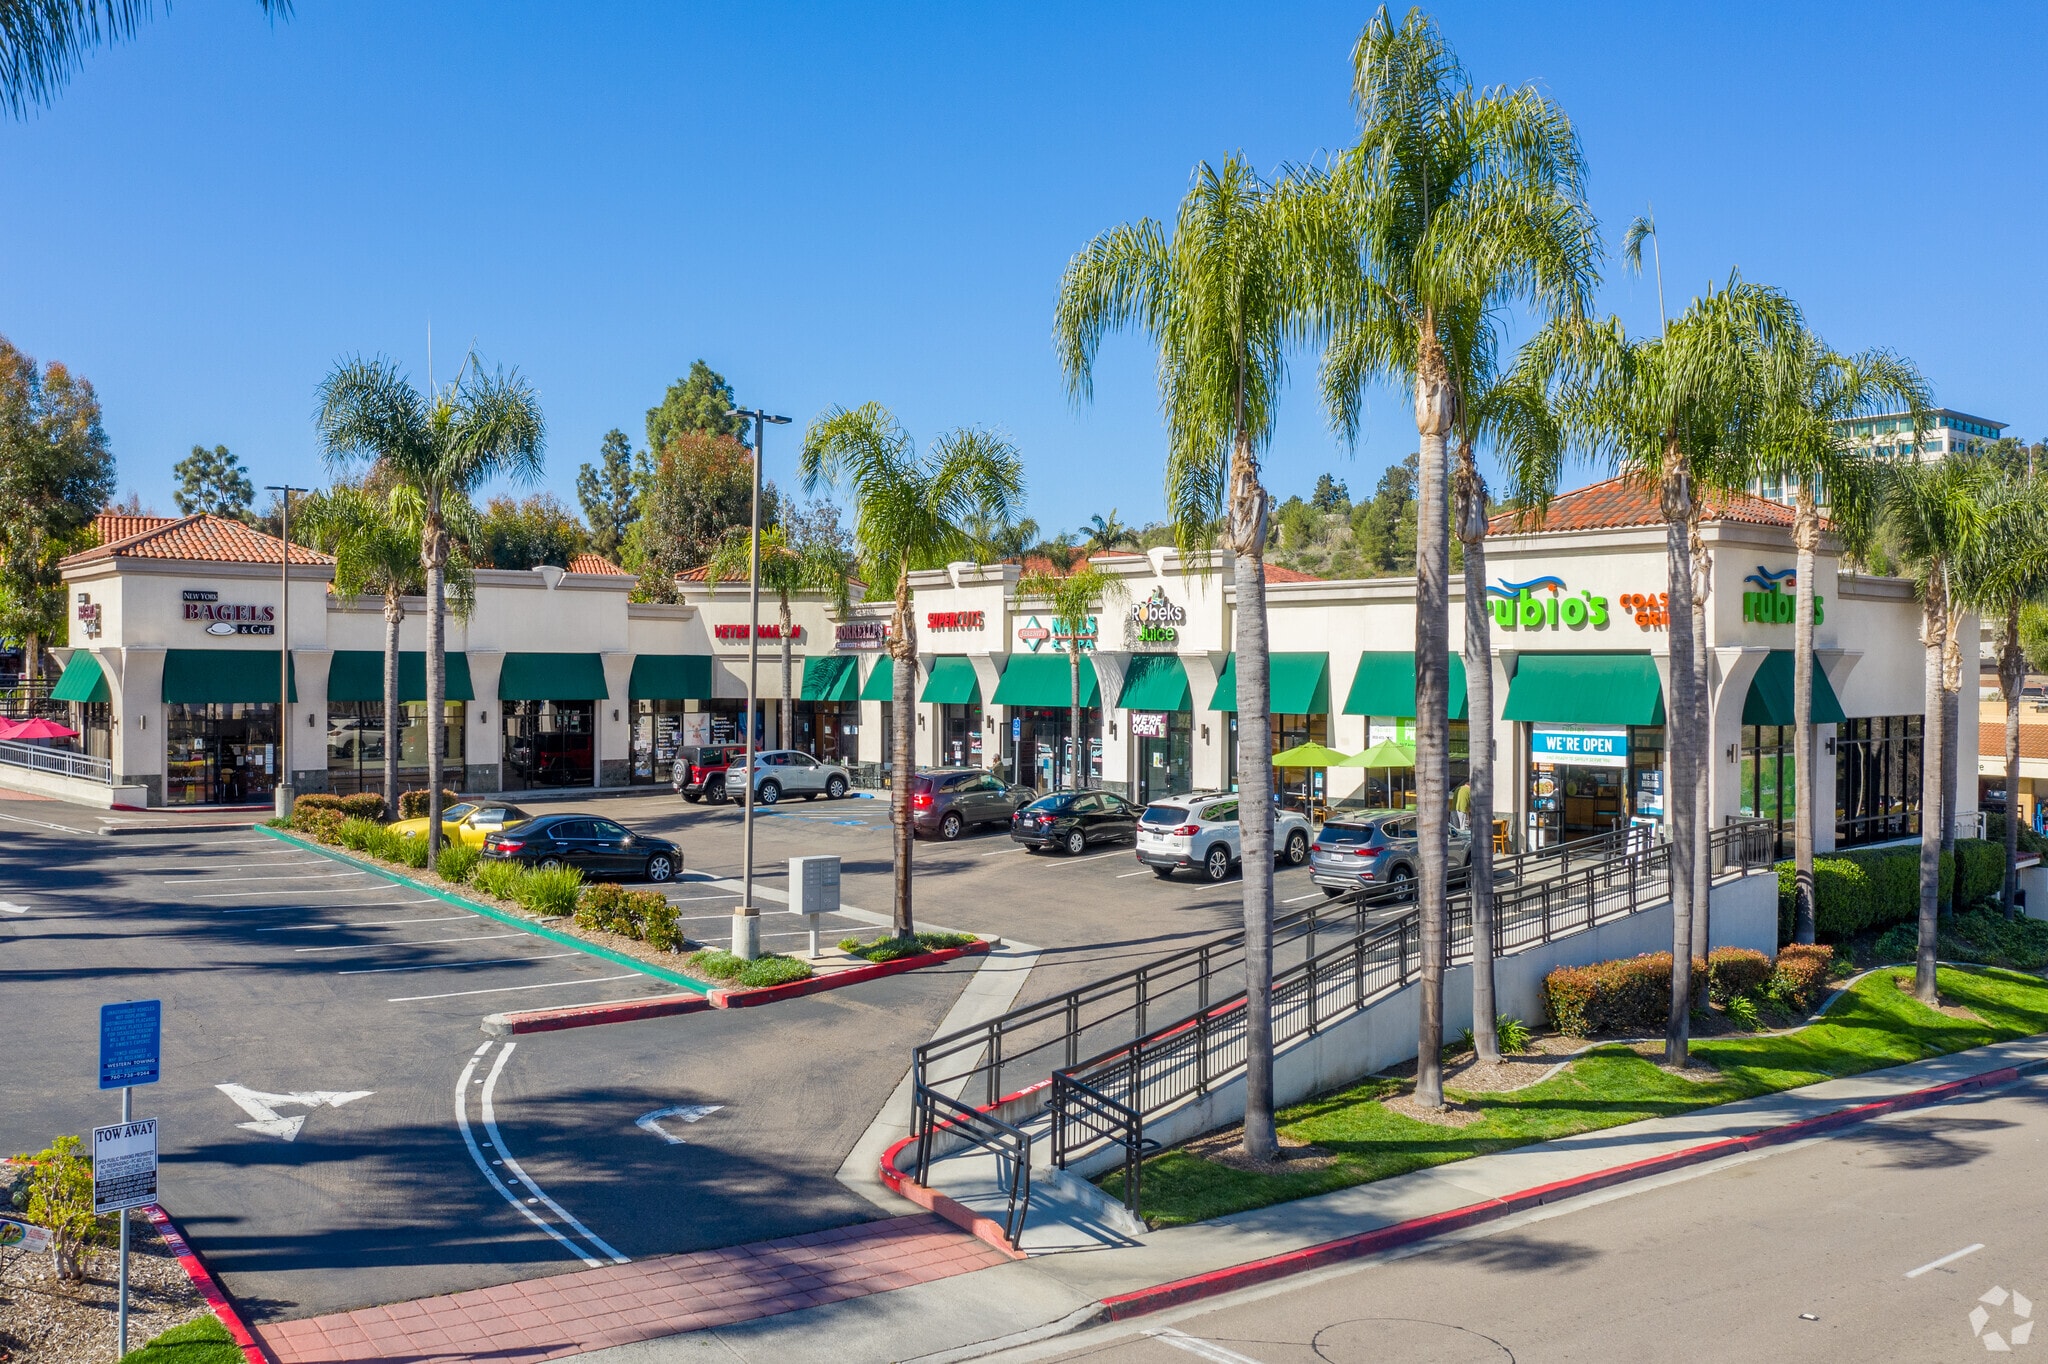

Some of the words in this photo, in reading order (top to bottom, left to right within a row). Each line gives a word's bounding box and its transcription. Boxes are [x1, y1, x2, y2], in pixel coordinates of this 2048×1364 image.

[1619, 592, 1669, 608] COAS
[184, 603, 275, 621] BAGELS
[927, 610, 982, 629] SUPERCUTS
[1131, 603, 1183, 621] Robeks
[242, 626, 248, 634] &
[1052, 616, 1097, 634] NALS
[1138, 624, 1175, 641] Juice
[1052, 639, 1062, 649] &
[1067, 639, 1094, 649] SPA
[1132, 714, 1163, 725] WE'RE
[1132, 724, 1157, 735] OPEN
[1546, 736, 1580, 751] WE'RE
[1583, 738, 1613, 752] OPEN
[97, 1128, 122, 1142] TOW
[125, 1122, 154, 1137] AWAY
